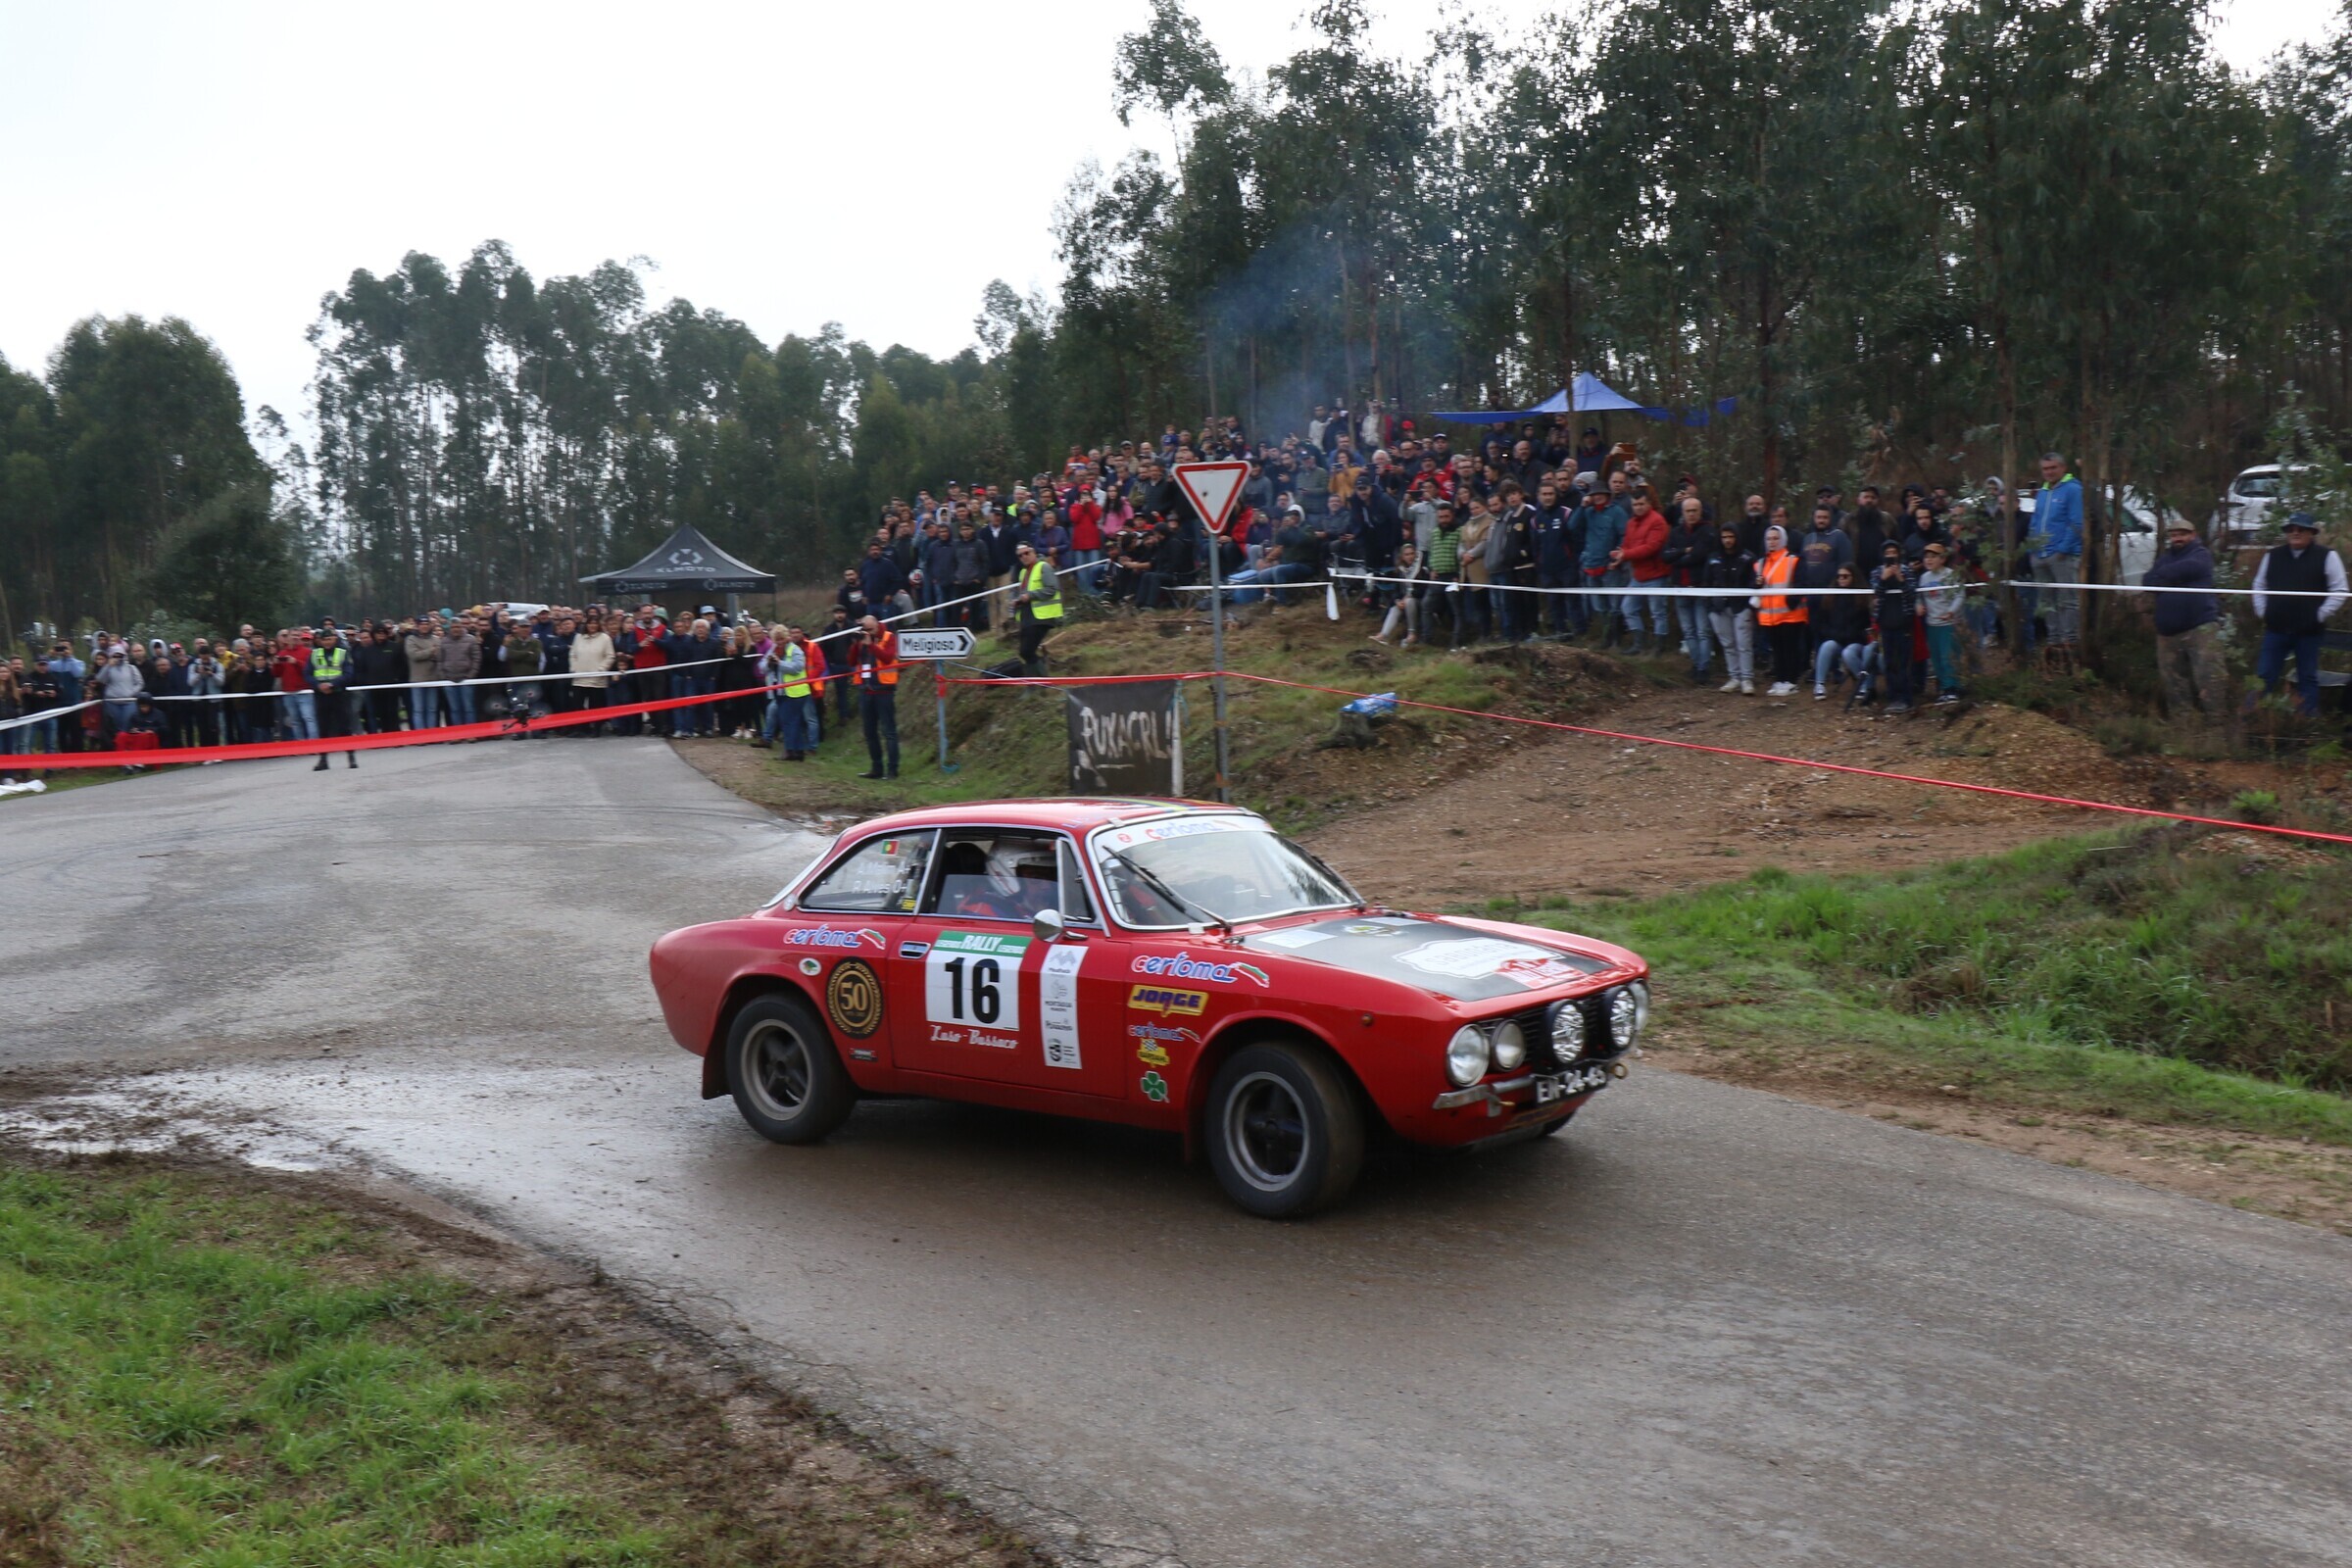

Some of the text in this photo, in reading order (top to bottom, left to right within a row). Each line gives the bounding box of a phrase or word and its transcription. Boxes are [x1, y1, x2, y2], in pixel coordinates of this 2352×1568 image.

[902, 637, 956, 654] Meligioso
[960, 934, 1004, 952] RALLY
[840, 981, 868, 1011] 50
[945, 956, 1001, 1024] 16
[1133, 988, 1201, 1011] JORGE
